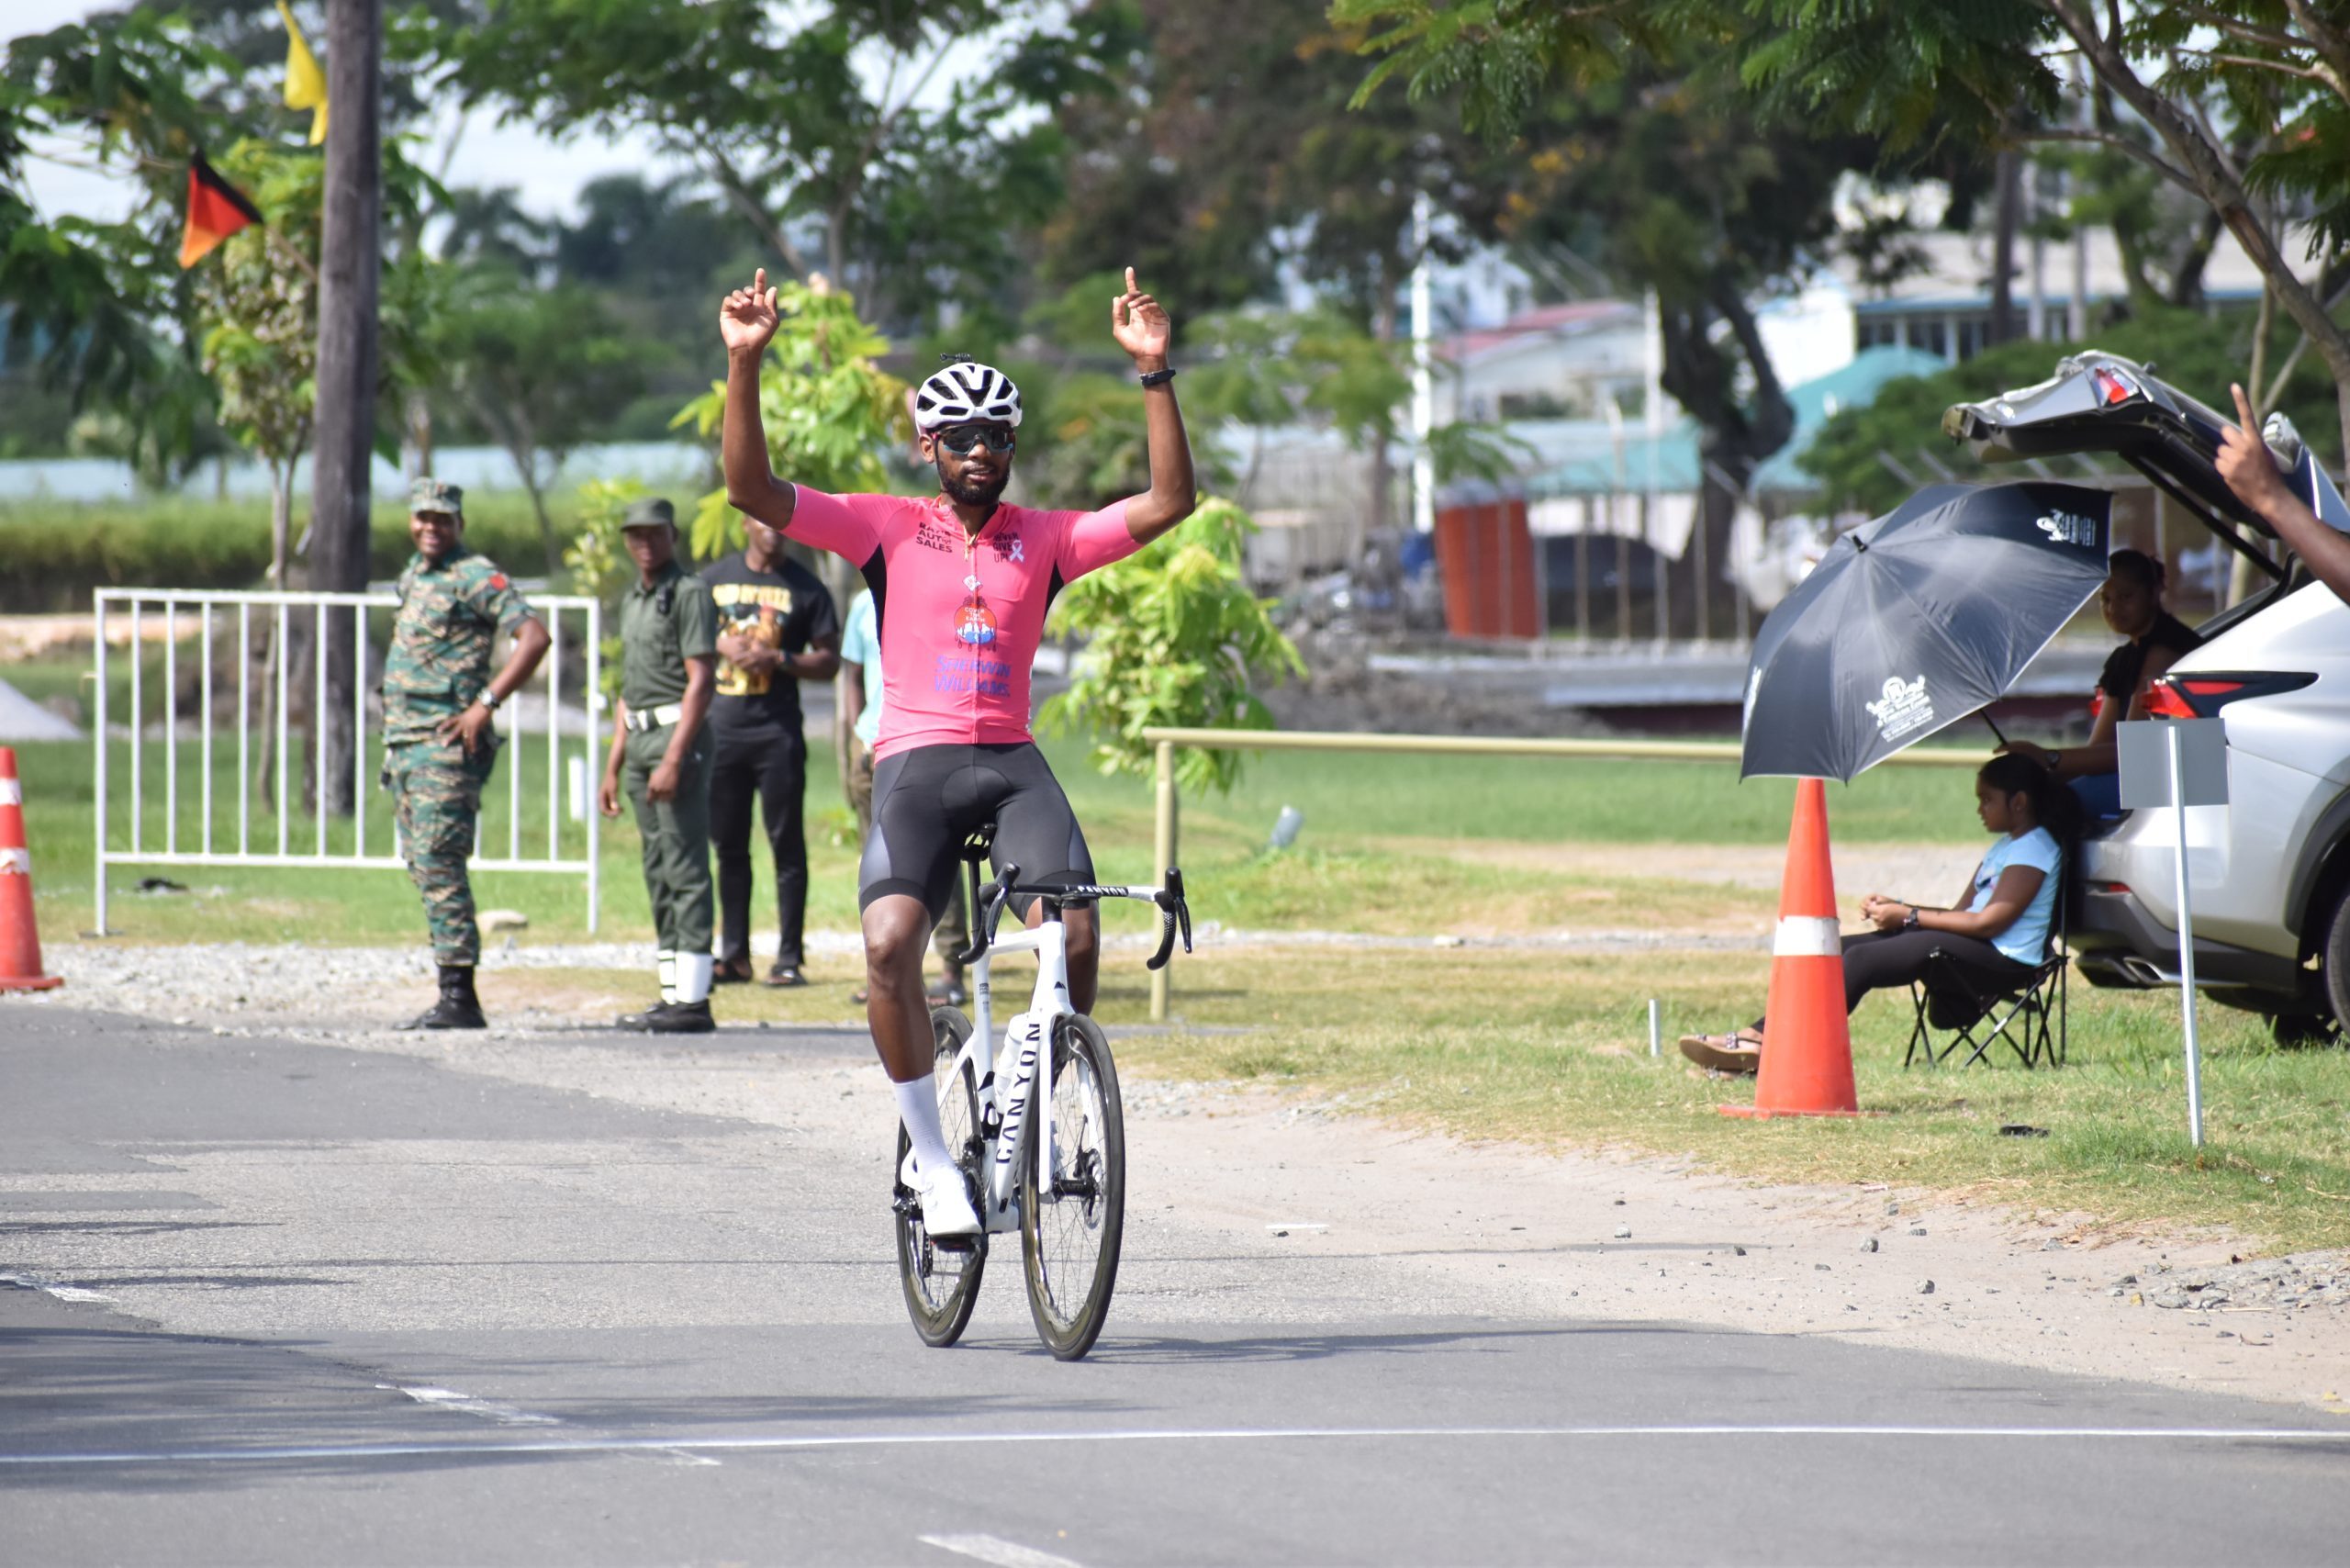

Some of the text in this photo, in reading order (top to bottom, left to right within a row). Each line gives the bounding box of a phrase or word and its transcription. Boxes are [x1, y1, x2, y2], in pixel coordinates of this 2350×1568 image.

[916, 536, 953, 554] SALES
[993, 542, 1013, 552] GIVE
[935, 655, 1012, 677] SHERWIN
[1078, 885, 1127, 896] CANYON
[995, 1024, 1040, 1164] CANYON
